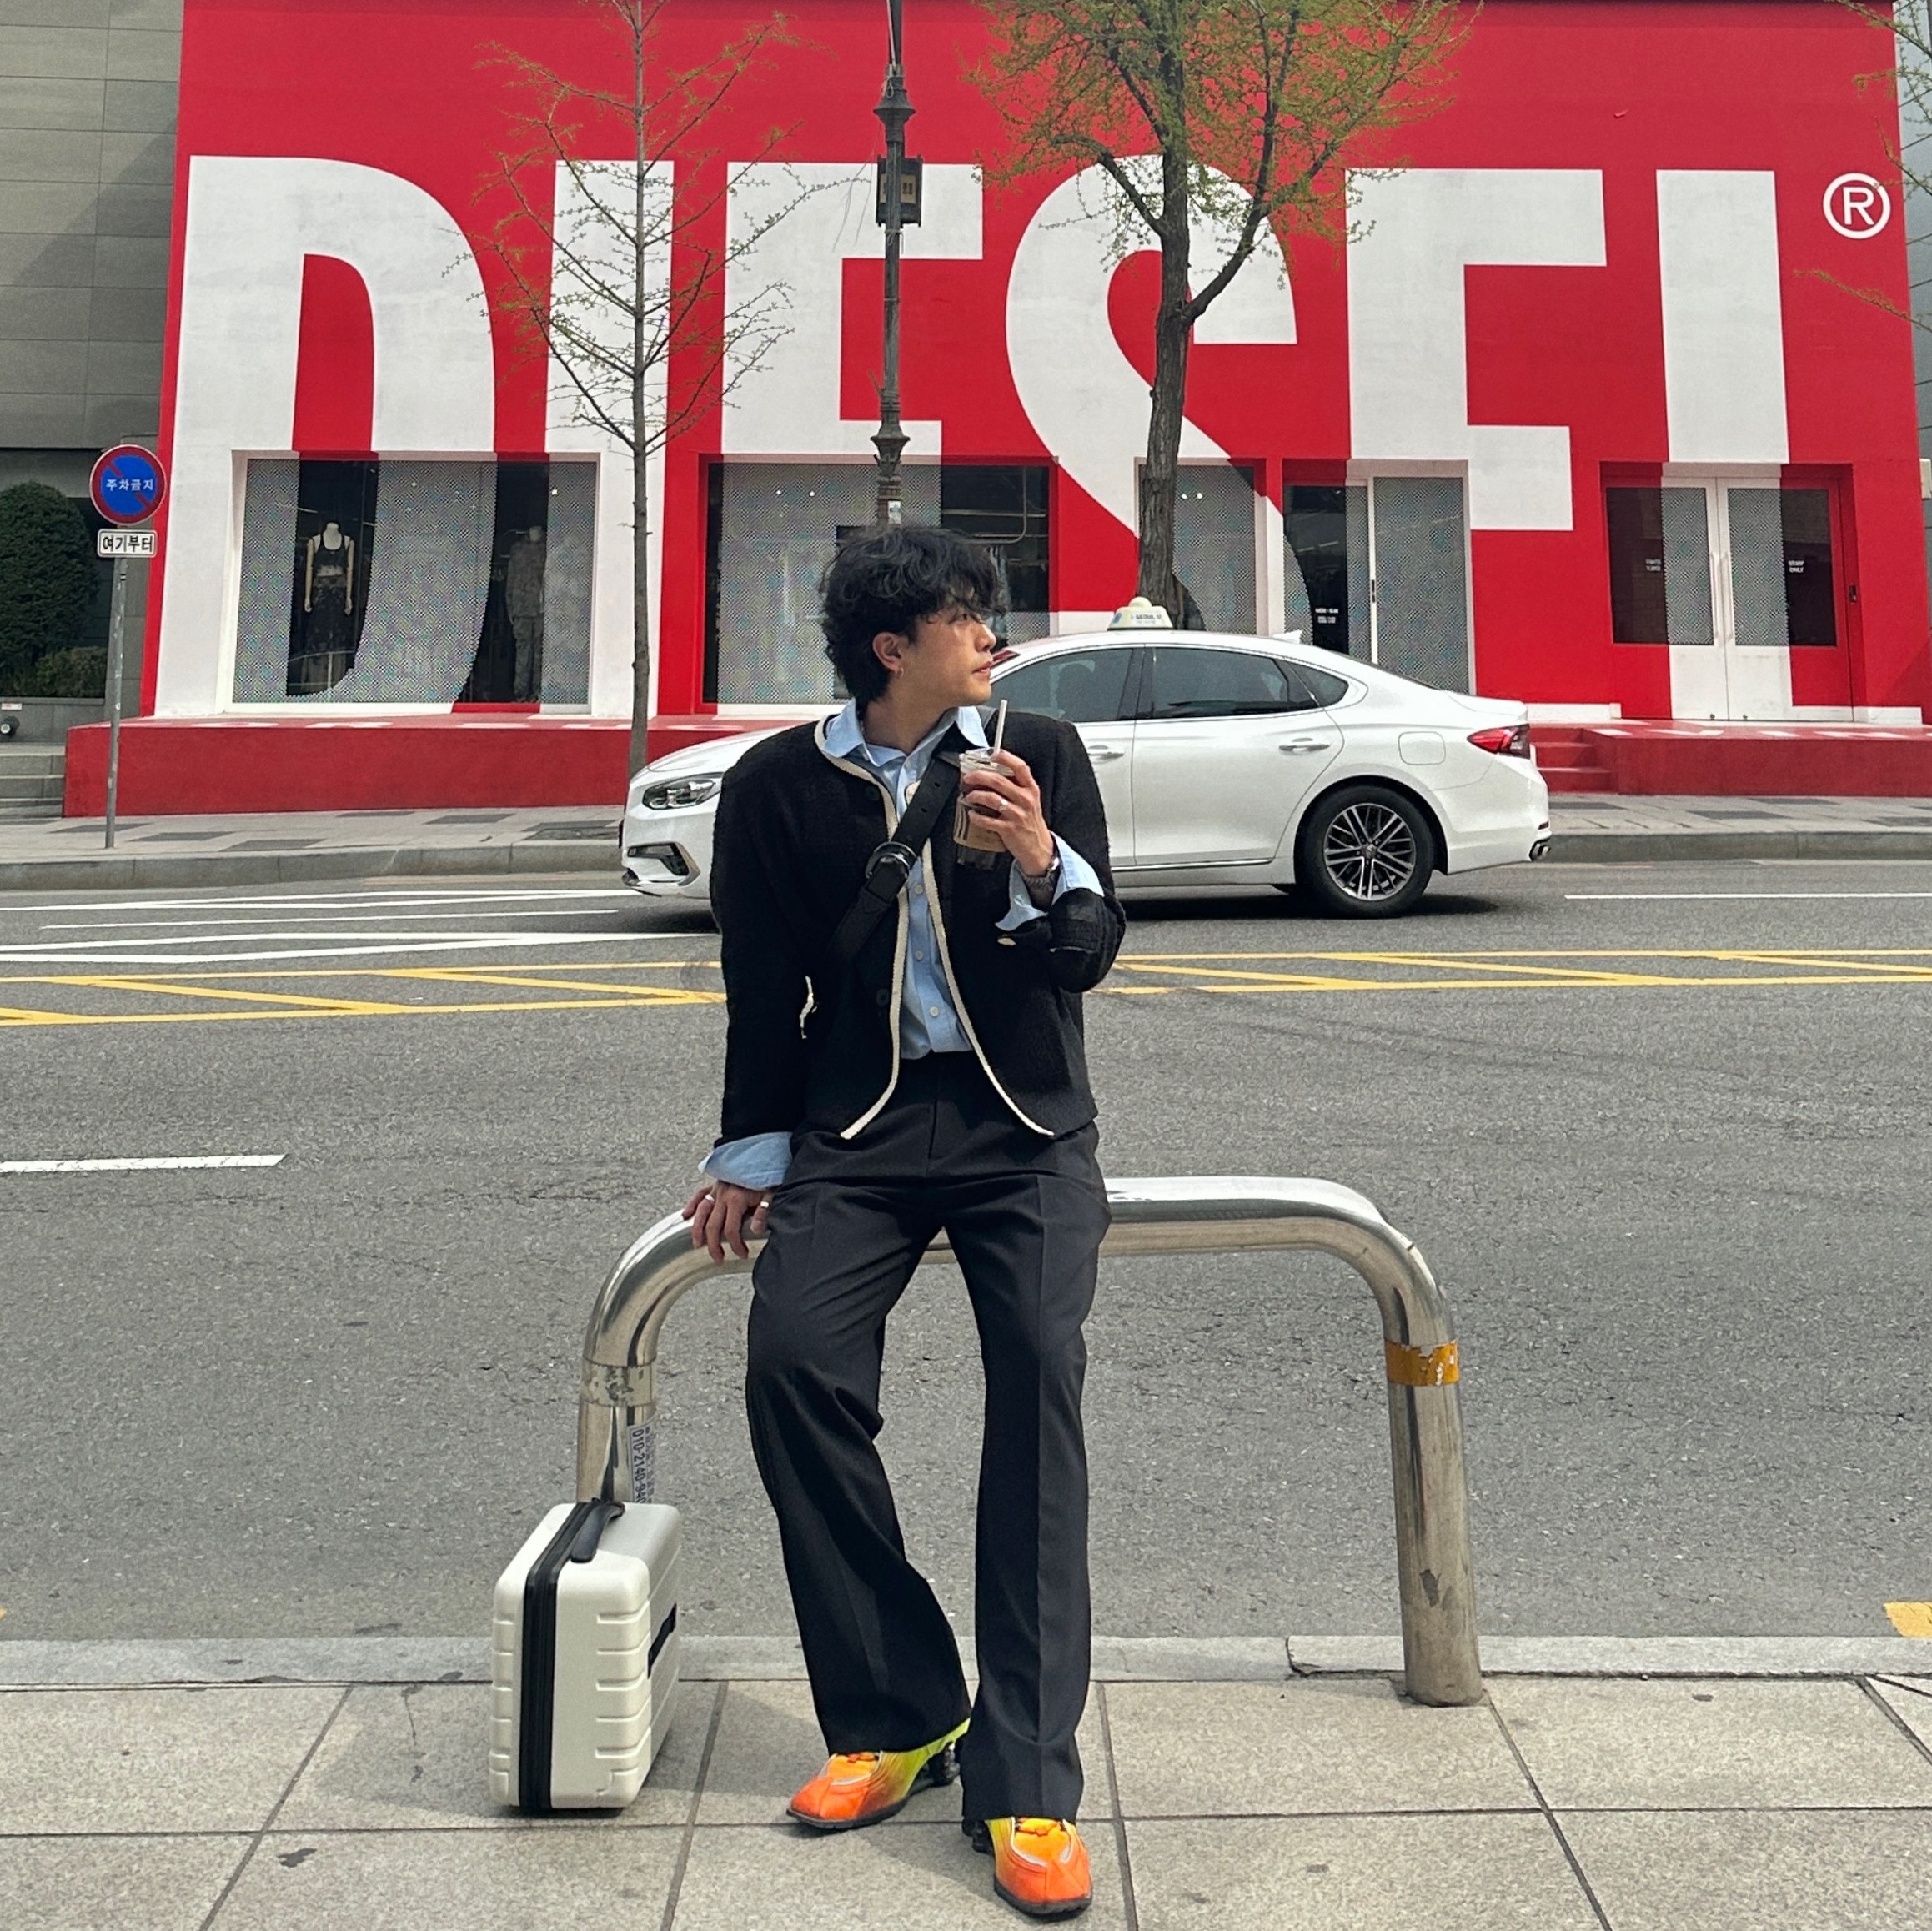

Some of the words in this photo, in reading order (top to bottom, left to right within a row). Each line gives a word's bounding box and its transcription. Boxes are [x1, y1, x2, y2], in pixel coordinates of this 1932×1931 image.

[153, 155, 1922, 724] DIESEL
[106, 479, 153, 492] 주차금지
[103, 534, 153, 553] 여기부터
